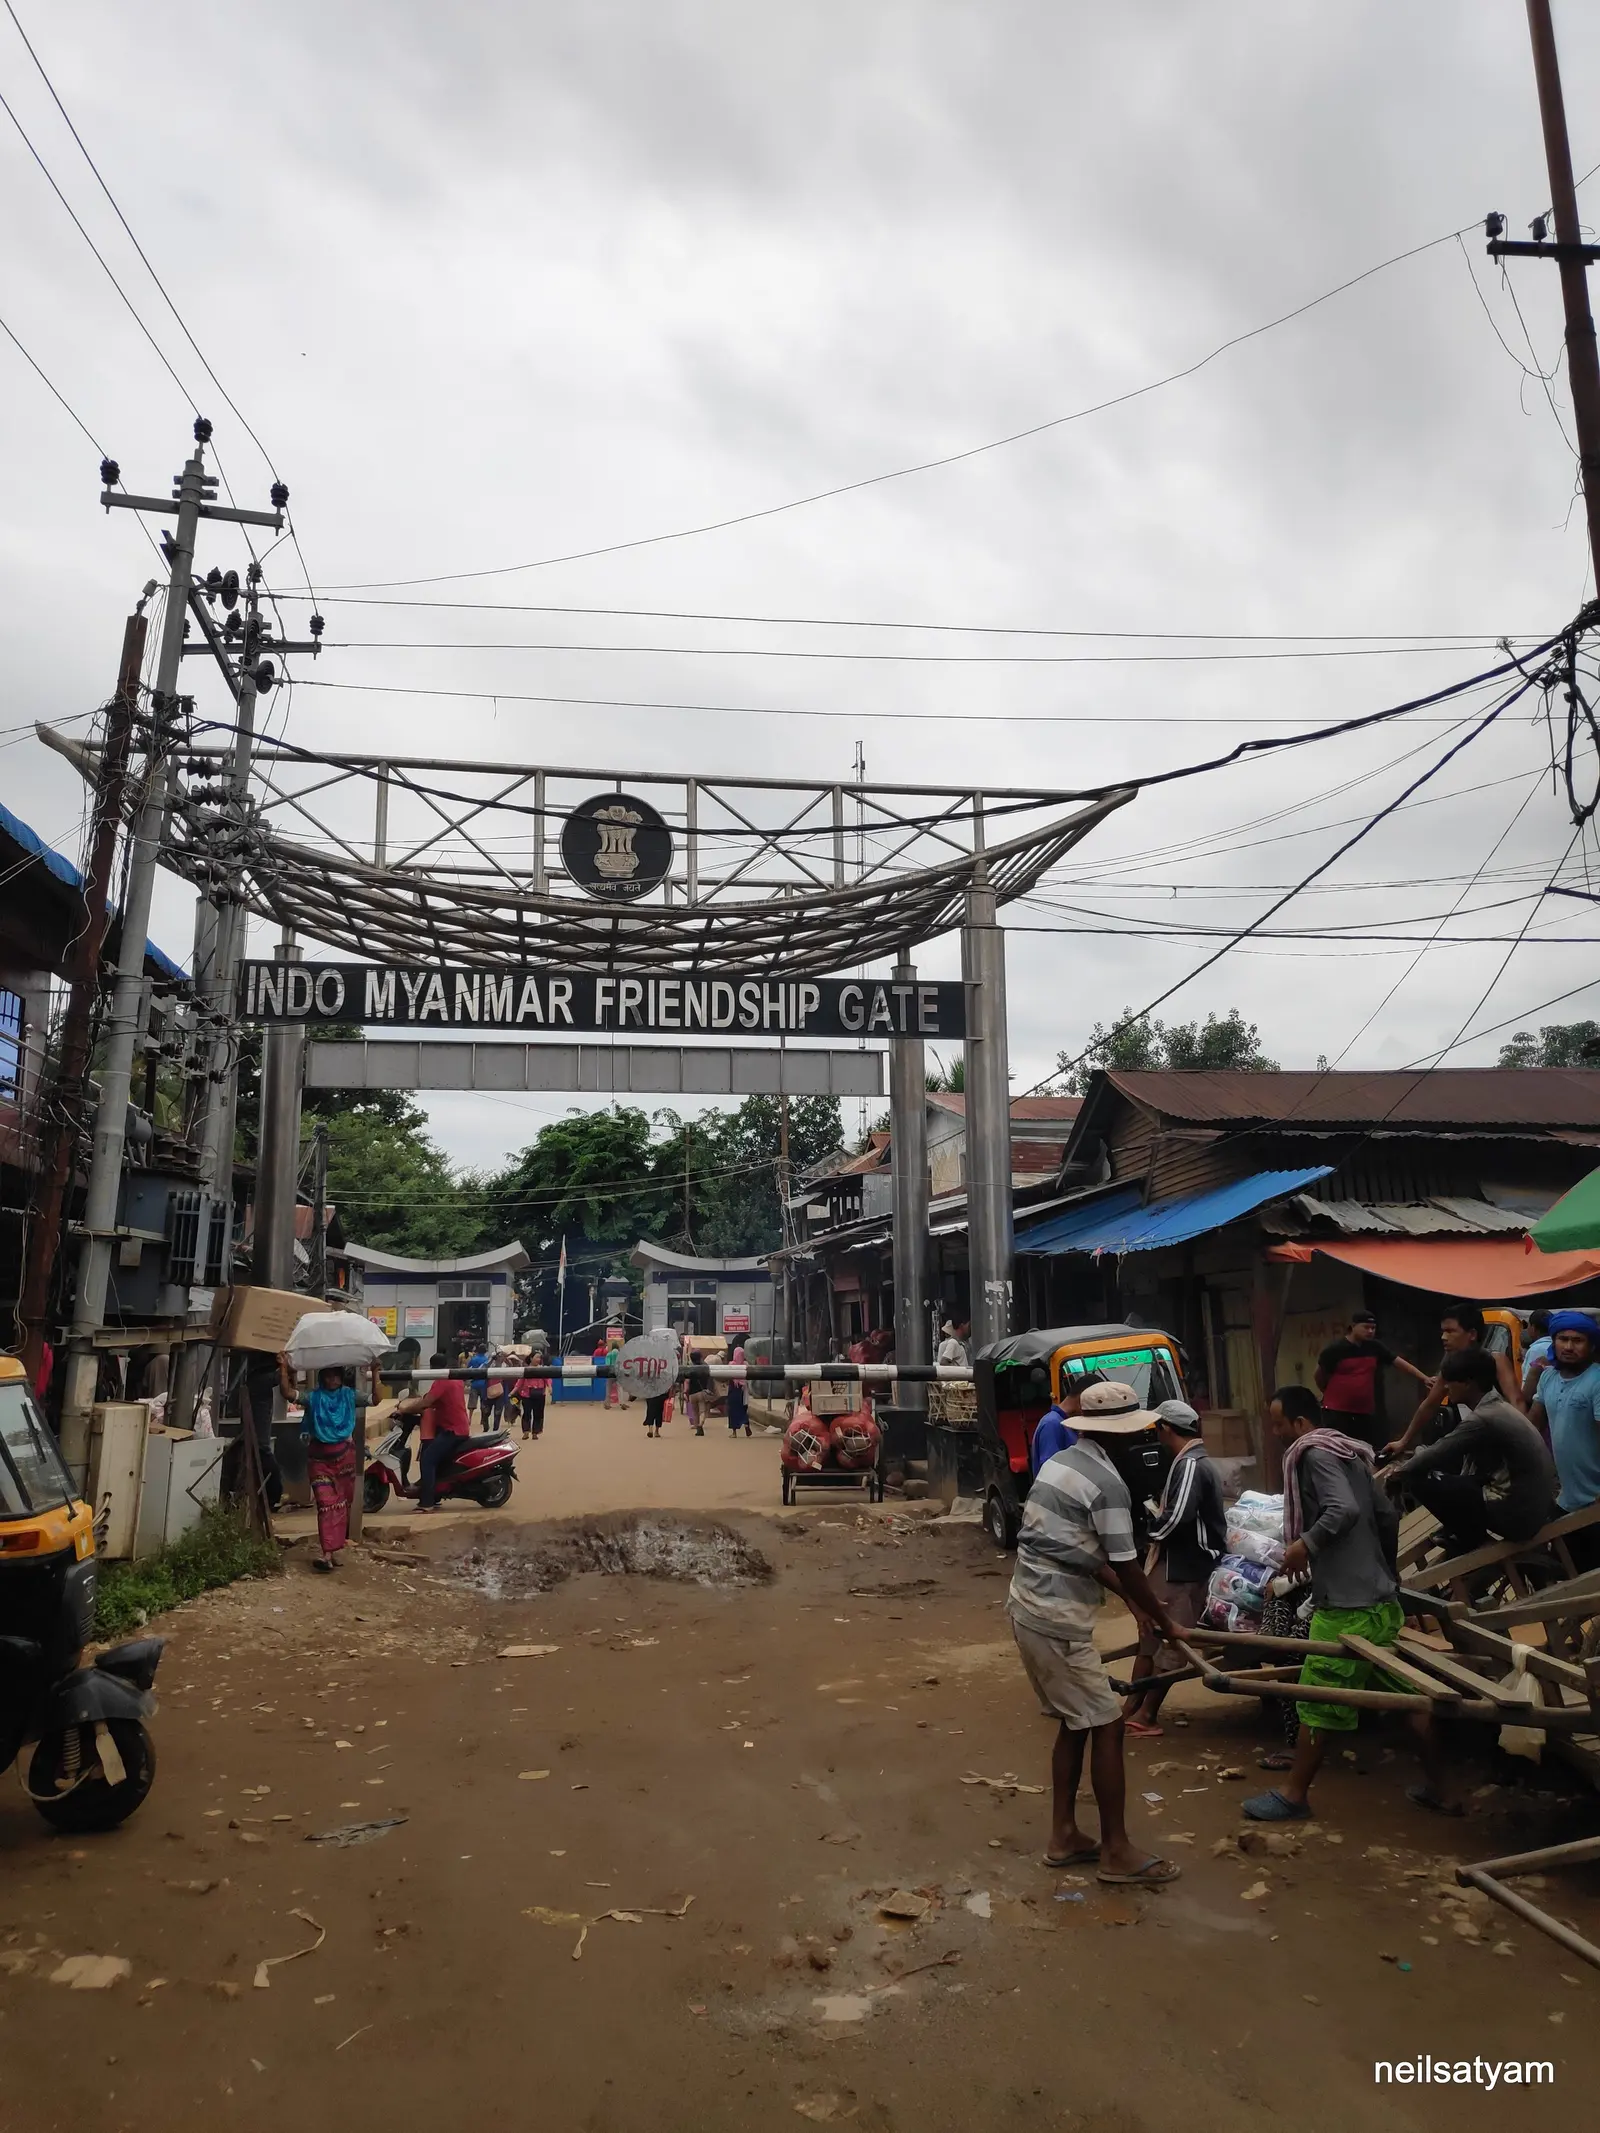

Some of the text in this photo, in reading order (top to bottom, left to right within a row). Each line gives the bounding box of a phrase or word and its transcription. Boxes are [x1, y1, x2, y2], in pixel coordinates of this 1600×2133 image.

[246, 965, 941, 1033] INDO MYANMAR FRIENDSHIP GATE
[622, 1356, 668, 1379] STOP
[1097, 1355, 1140, 1366] SONY
